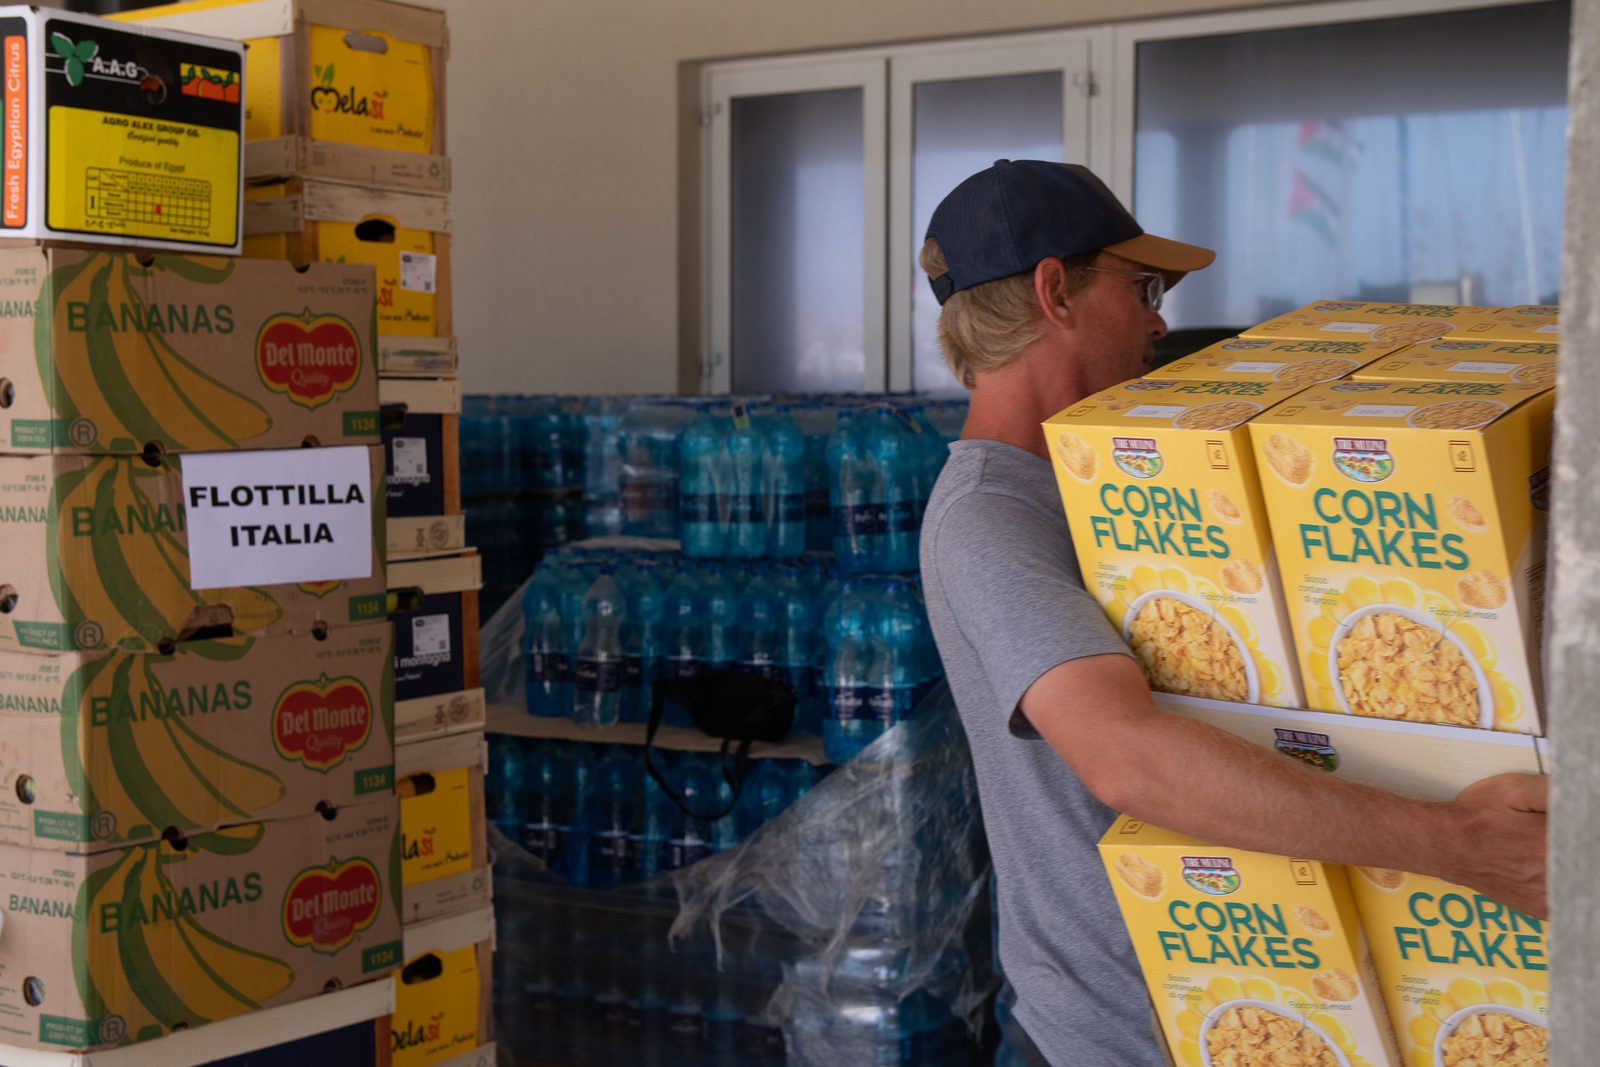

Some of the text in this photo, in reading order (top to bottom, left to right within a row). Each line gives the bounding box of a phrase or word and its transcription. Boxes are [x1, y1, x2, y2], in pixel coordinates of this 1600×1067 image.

[7, 42, 23, 219] Fresh Egyptian Citrus
[102, 117, 129, 128] AGRO
[131, 119, 155, 131] ALEX
[157, 123, 186, 136] GROUP
[119, 156, 186, 174] Produce of Egypt
[67, 301, 235, 335] BANANAS
[1364, 307, 1458, 317] FLAKES
[266, 342, 355, 367] Del Monte
[1271, 345, 1367, 354] FLAKES
[290, 368, 330, 387] Quality
[1201, 380, 1273, 389] CORN
[1173, 386, 1271, 397] FLAKES
[1392, 386, 1507, 396] FLAKES
[351, 417, 376, 431] 1134
[190, 483, 365, 508] FLOTTILLA
[1100, 483, 1203, 522] CORN
[1313, 487, 1439, 531] CORN
[230, 522, 334, 548] ITALIA
[1091, 515, 1230, 559] FLAKES
[1299, 522, 1470, 571] FLAKES
[357, 602, 380, 616] 1134
[91, 680, 253, 728] BANANAS
[281, 702, 366, 736] Del Monte
[306, 732, 343, 753] Quality
[362, 773, 387, 789] 1134
[101, 872, 263, 934] BANANAS
[291, 882, 375, 922] Del Monte
[1408, 891, 1544, 934] CORN
[313, 914, 350, 936] Quality
[1168, 899, 1289, 936] CORN
[369, 950, 394, 966] 1134
[1157, 929, 1321, 970] FLAKES
[1393, 926, 1547, 970] FLAKE
